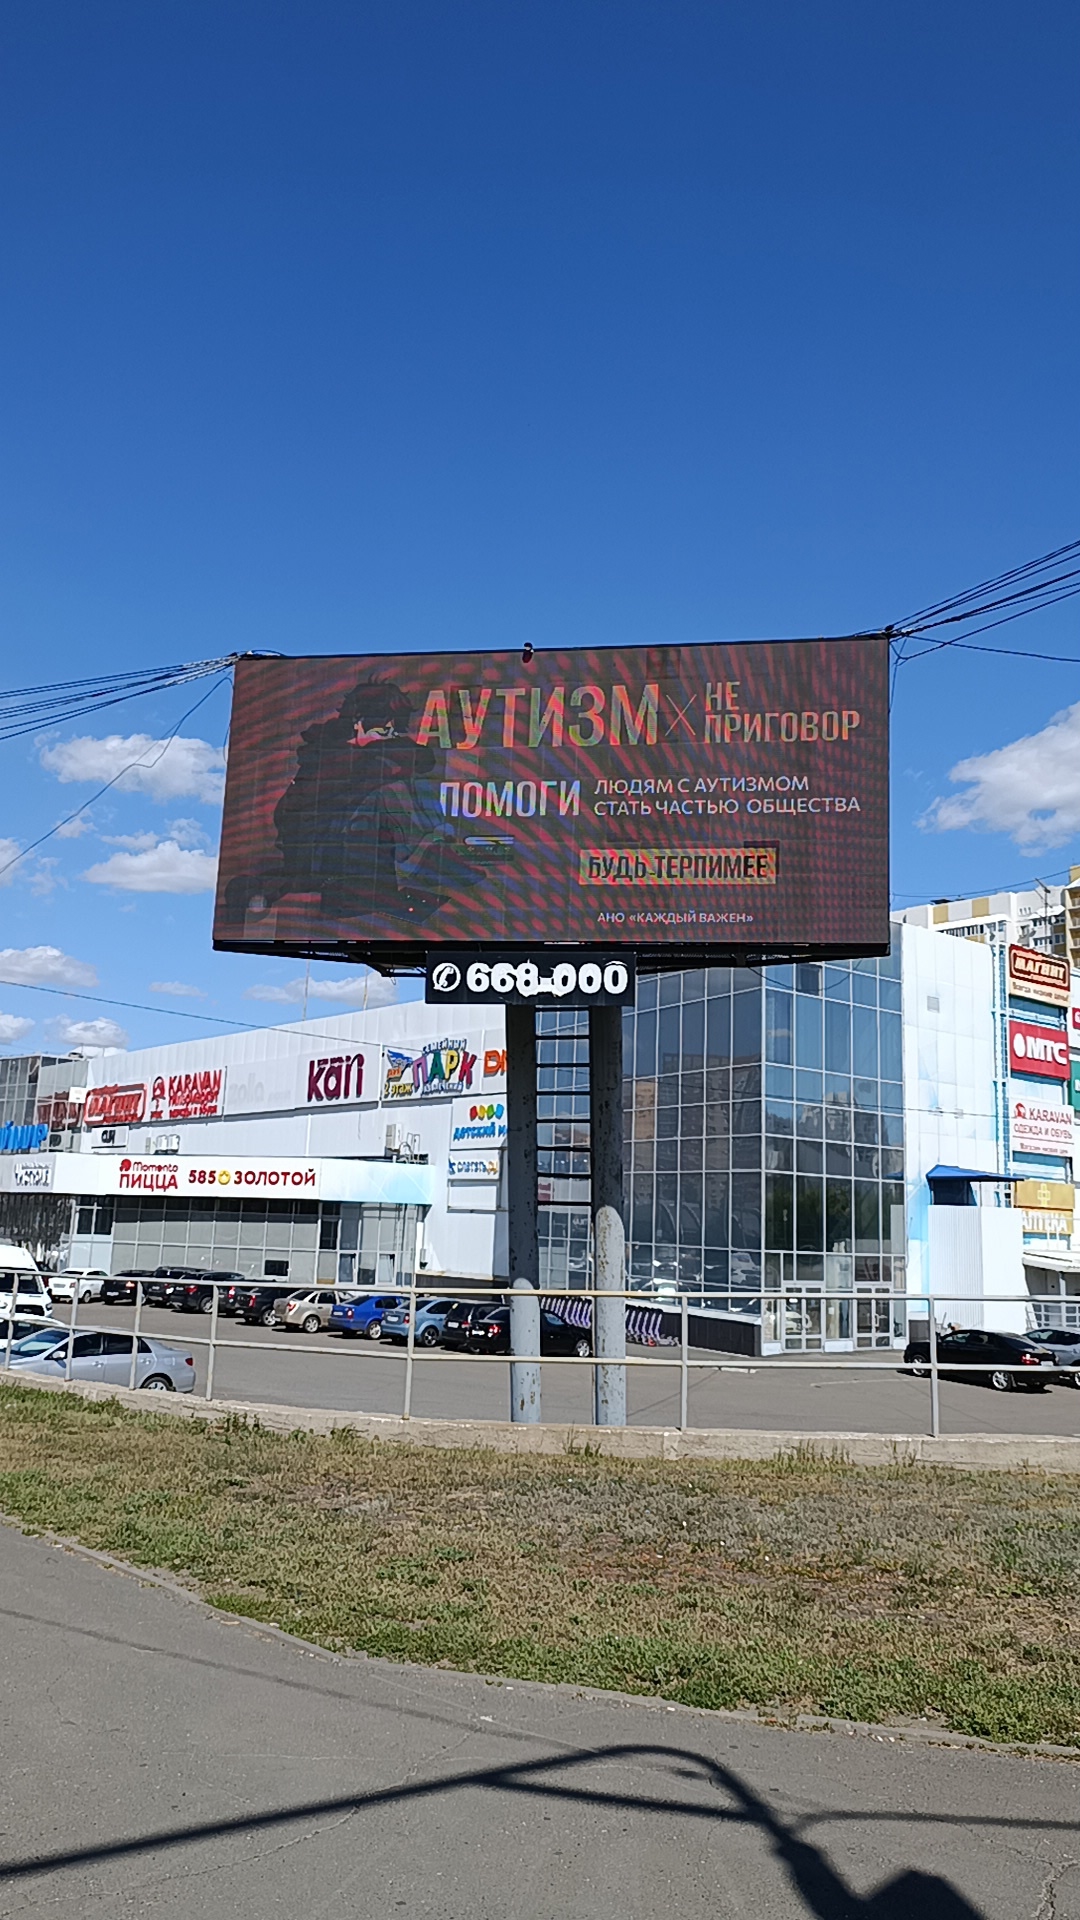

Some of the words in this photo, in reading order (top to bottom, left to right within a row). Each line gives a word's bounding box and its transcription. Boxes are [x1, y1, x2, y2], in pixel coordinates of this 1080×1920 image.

[705, 681, 741, 711] НЕ
[416, 683, 660, 750] АУТИЗМ
[704, 710, 861, 744] ПРИГОВОР
[439, 779, 581, 817] ПОМОГИ
[594, 778, 674, 796] ЛЮДЯМ
[677, 778, 690, 793] С
[693, 775, 809, 792] АУТИЗМОМ
[593, 800, 652, 816] СТАТЬ
[655, 798, 739, 815] ЧАСТЬЮ
[746, 796, 861, 816] ОБЩЕСТВА
[588, 856, 647, 882] БУДЬ
[654, 855, 768, 879] ТЕРПИМЕЕ
[597, 911, 625, 923] АНО
[629, 910, 696, 924] «КАЖДЫЙ
[699, 912, 754, 923] ВАЖЕН»
[466, 962, 629, 997] 668-000
[1025, 1035, 1068, 1066] МТС
[412, 1049, 477, 1091] ПАРК
[1029, 1107, 1073, 1125] KARAVAN
[133, 1161, 179, 1173] Momento
[188, 1169, 217, 1184] 585
[233, 1168, 316, 1187] ЗОЛОТОЙ
[119, 1173, 178, 1192] ПИЦЦА
